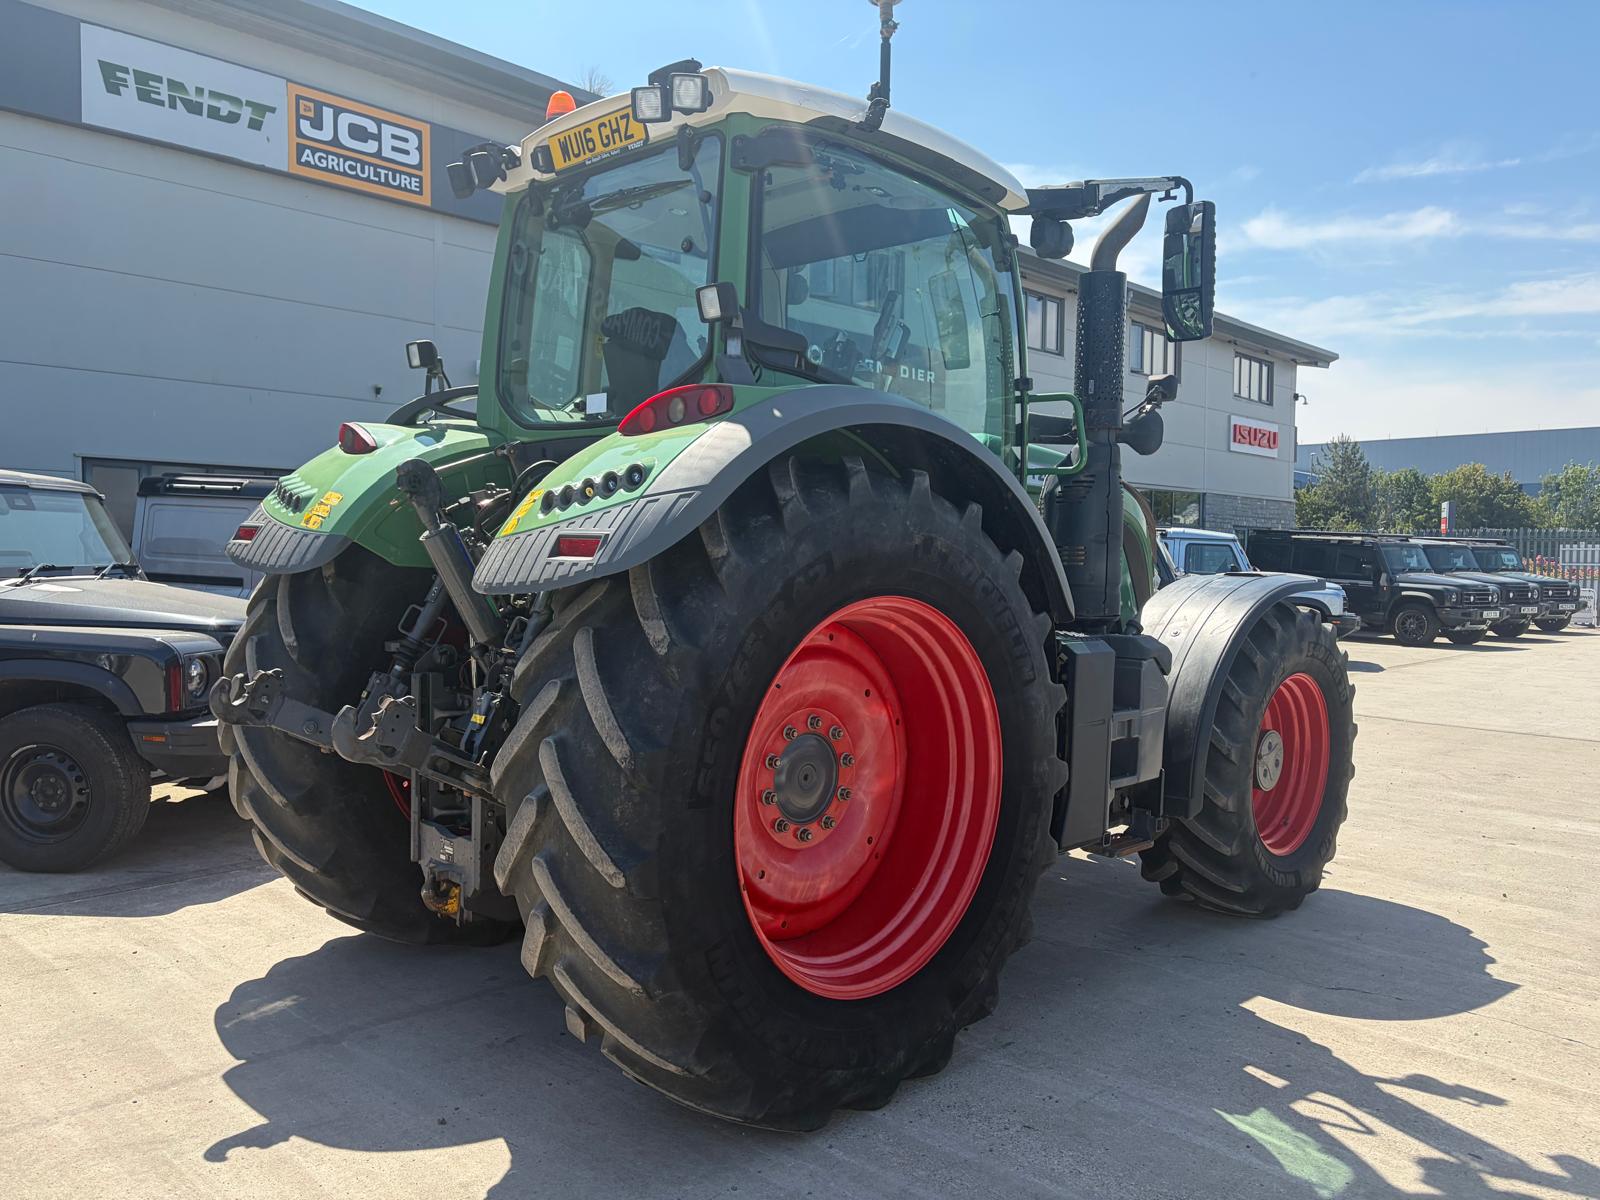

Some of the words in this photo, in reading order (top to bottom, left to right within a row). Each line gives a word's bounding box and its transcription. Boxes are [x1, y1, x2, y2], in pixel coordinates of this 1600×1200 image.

[97, 59, 277, 132] FENDT
[299, 106, 421, 166] JCB
[557, 127, 596, 164] WU16
[597, 112, 635, 148] GHZ
[300, 149, 421, 192] AGRICULTURE
[1232, 423, 1279, 450] ISUZU
